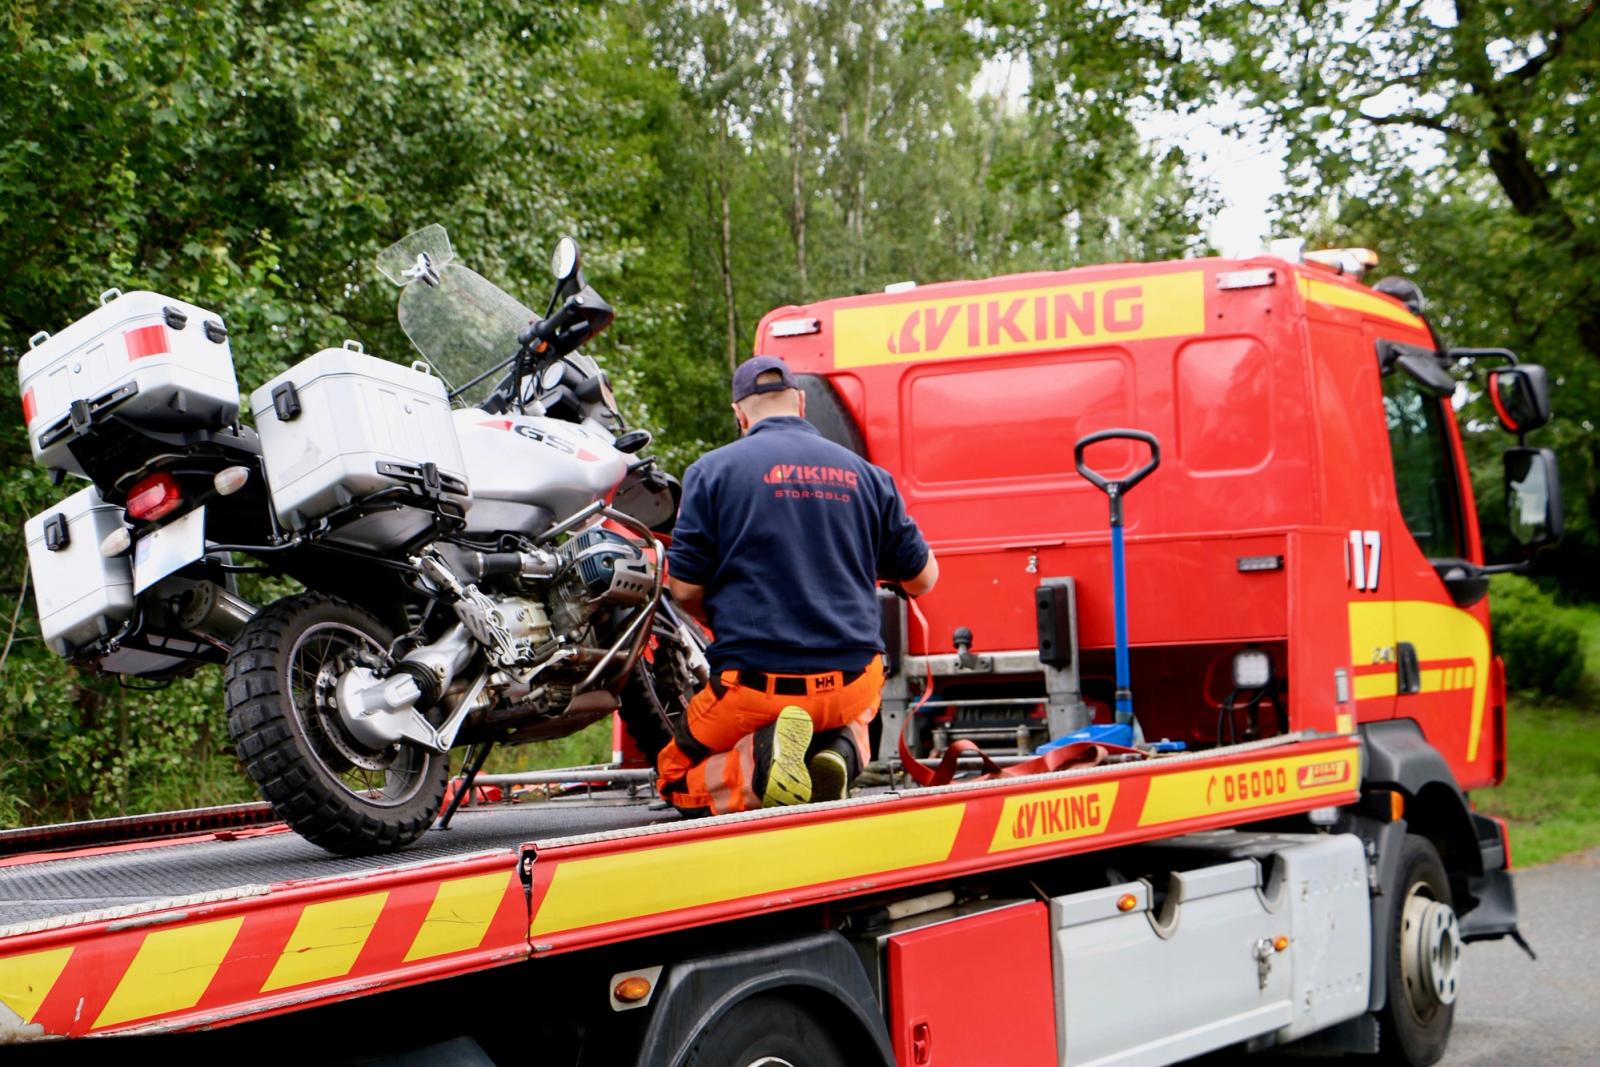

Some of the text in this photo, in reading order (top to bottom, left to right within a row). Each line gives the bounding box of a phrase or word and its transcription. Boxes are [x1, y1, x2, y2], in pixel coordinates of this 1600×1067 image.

[924, 285, 1144, 353] VIKING
[514, 424, 576, 454] GS
[781, 464, 858, 486] VIKING
[1344, 530, 1381, 589] 17
[815, 676, 835, 689] HH
[1224, 767, 1286, 803] 06000
[1025, 793, 1100, 839] VIKING
